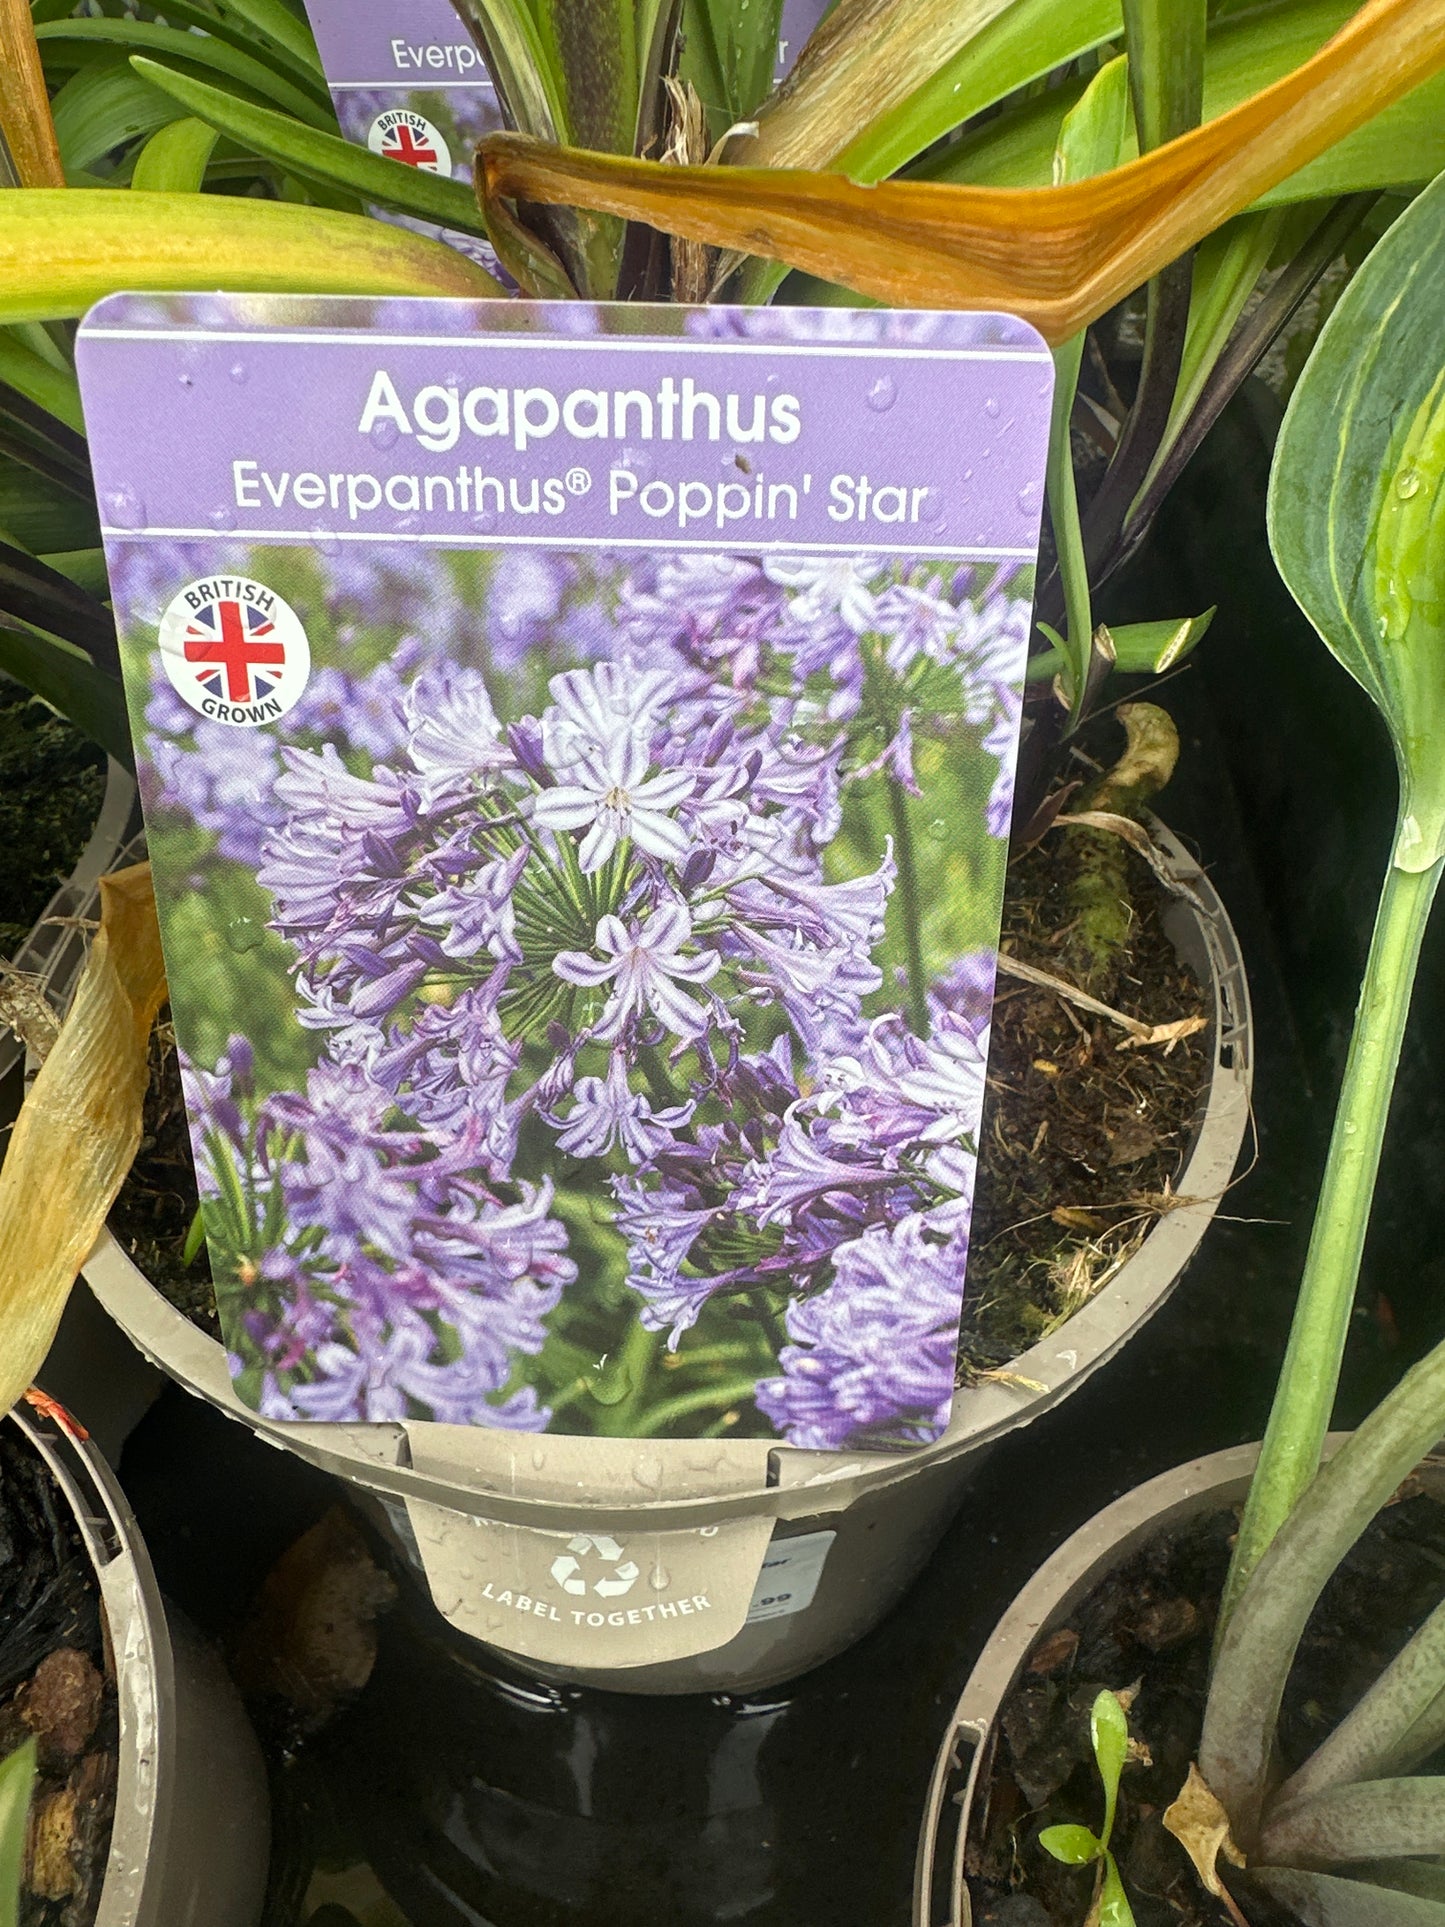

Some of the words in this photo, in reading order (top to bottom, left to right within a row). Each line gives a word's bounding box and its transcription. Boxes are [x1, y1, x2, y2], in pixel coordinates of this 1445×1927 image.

[377, 112, 426, 131] BRITISH
[358, 370, 802, 453] Agapanthus
[609, 470, 812, 528] Poppin'
[827, 474, 929, 524] Star
[184, 580, 275, 612] BRITISH
[201, 698, 283, 724] GROWN
[481, 1582, 561, 1622] LABEL
[571, 1594, 712, 1627] TOGETHER
